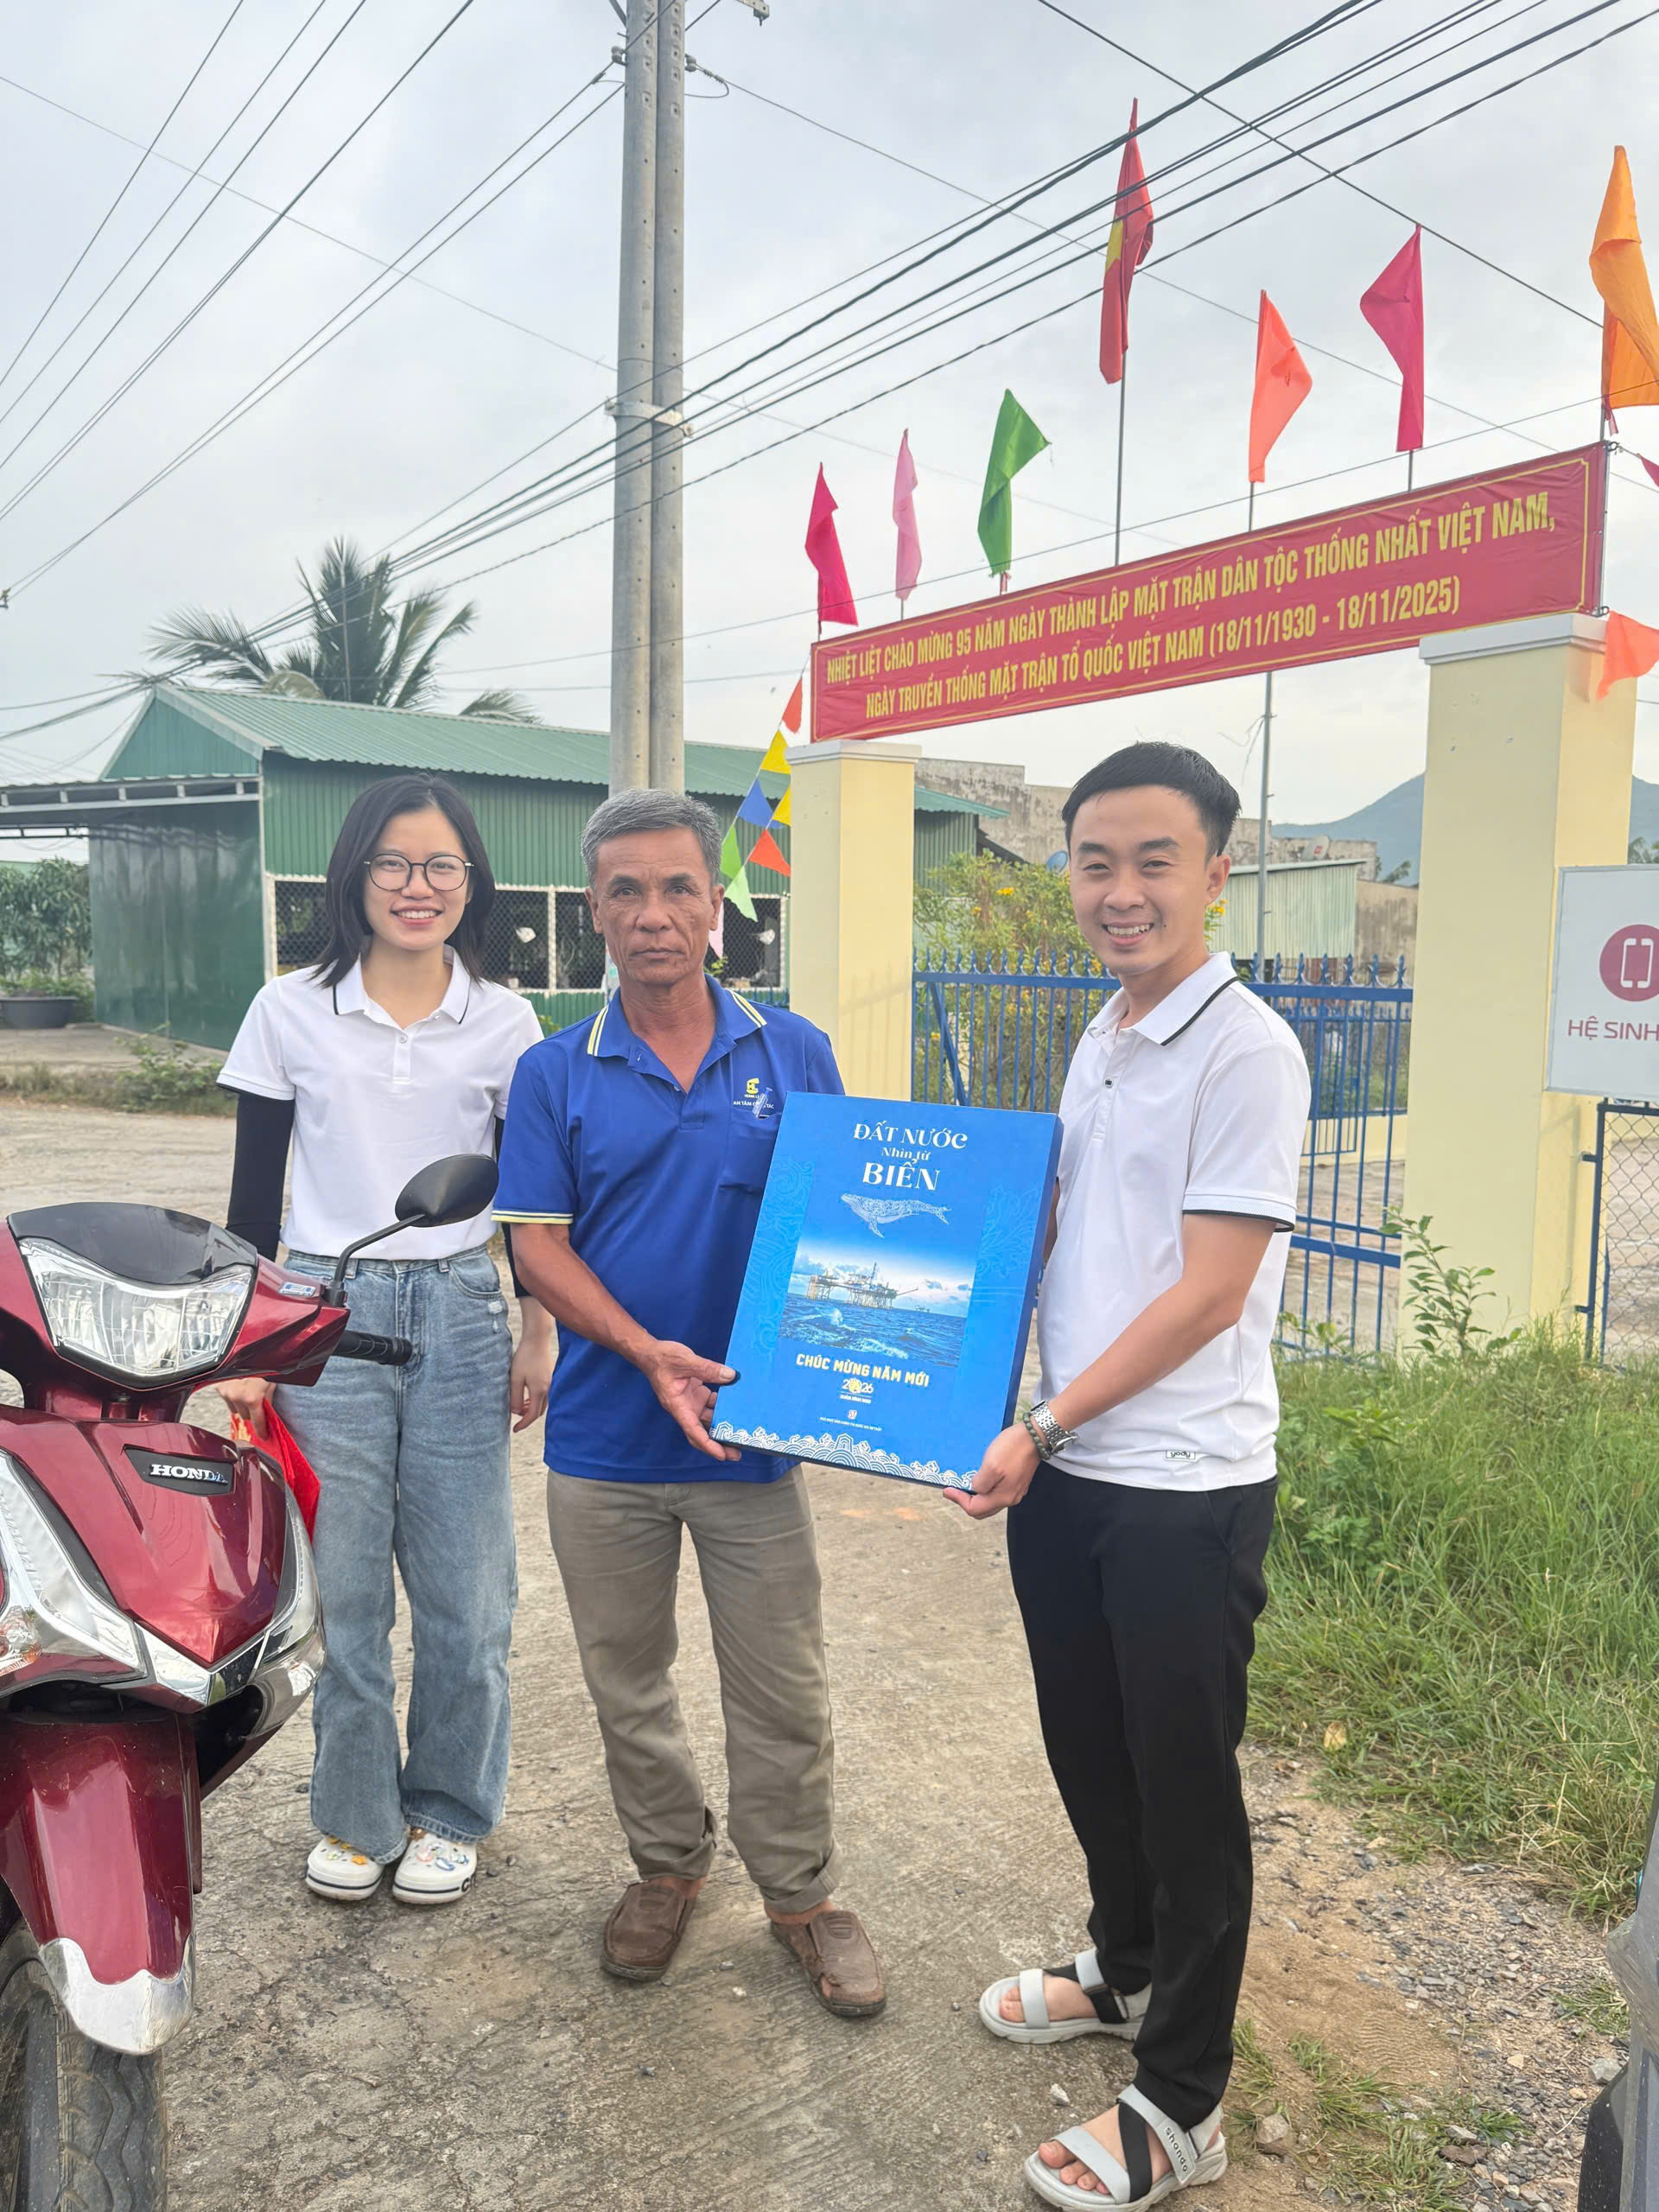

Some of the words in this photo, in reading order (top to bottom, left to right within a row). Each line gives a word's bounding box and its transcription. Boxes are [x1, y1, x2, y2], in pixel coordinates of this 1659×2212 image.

[827, 650, 857, 685] NHIỆT
[859, 645, 881, 681] LIỆT
[884, 637, 914, 671] CHÀO
[917, 630, 953, 664] MỪNG
[957, 628, 971, 657] 95
[975, 617, 1005, 652] NĂM
[1008, 606, 1046, 645] NGÀY
[1049, 596, 1096, 635] THÀNH
[1101, 585, 1129, 630] LẬP
[1134, 575, 1168, 621] MẶT
[1173, 565, 1217, 611] TRẬN
[1221, 555, 1258, 598] DÂN
[1263, 546, 1299, 594] TỘC
[1304, 526, 1370, 580] THỐNG
[1375, 508, 1432, 565] NHẤT
[1437, 501, 1486, 555] VIỆT
[1491, 491, 1555, 539] NAM,
[865, 685, 896, 719] NGÀY
[898, 672, 943, 713] TRUYỀN
[945, 664, 986, 705] THỐNG
[989, 660, 1019, 701] MẶT
[1021, 652, 1058, 693] TRẬN
[1061, 639, 1081, 683] TỔ
[1083, 634, 1123, 682] QUỐC
[1128, 631, 1161, 675] VIỆT
[1165, 626, 1205, 664] NAM
[1210, 603, 1317, 658] (18/11/1930
[1337, 575, 1460, 632] 18/11/2025)
[1567, 1015, 1599, 1040] HỆ
[1603, 1021, 1659, 1042] SINH
[853, 1120, 899, 1143] ĐẤT
[901, 1127, 969, 1149] NƯỚC
[880, 1147, 912, 1160] Nhìn
[916, 1149, 932, 1160] từ
[862, 1158, 941, 1192] BIỂN
[796, 1353, 831, 1370] CHÚC
[833, 1359, 870, 1377] MỪNG
[872, 1365, 902, 1382] NĂM
[904, 1371, 931, 1388] MỚI
[150, 1464, 228, 1484] HONDA
[1166, 2127, 1188, 2171] shondo
